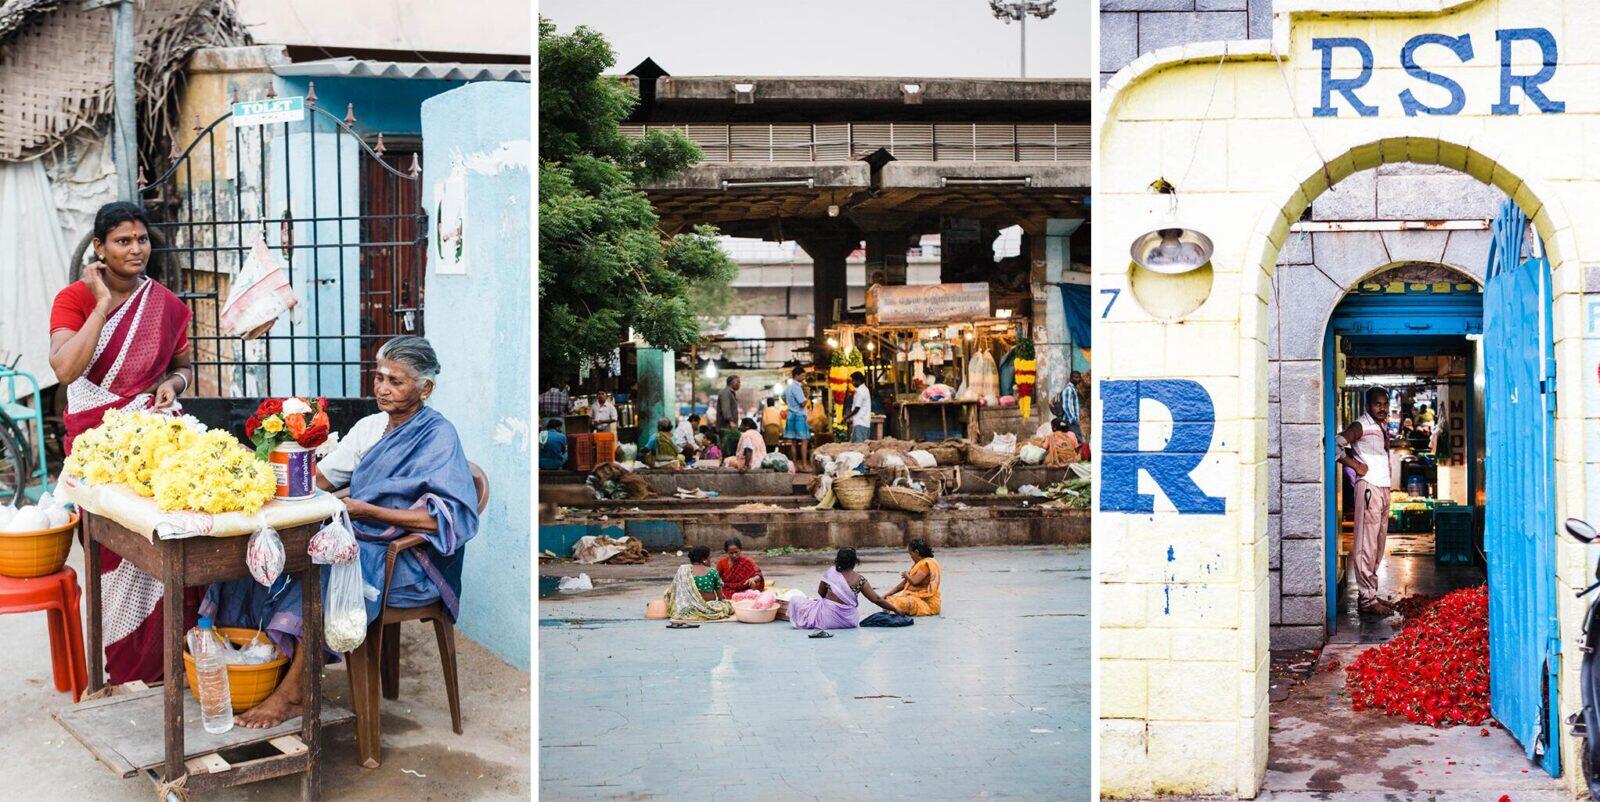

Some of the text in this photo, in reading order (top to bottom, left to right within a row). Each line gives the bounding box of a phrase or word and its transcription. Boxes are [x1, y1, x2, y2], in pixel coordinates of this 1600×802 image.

[1312, 27, 1566, 117] RSR
[1100, 288, 1121, 319] 7
[1100, 379, 1226, 515] R
